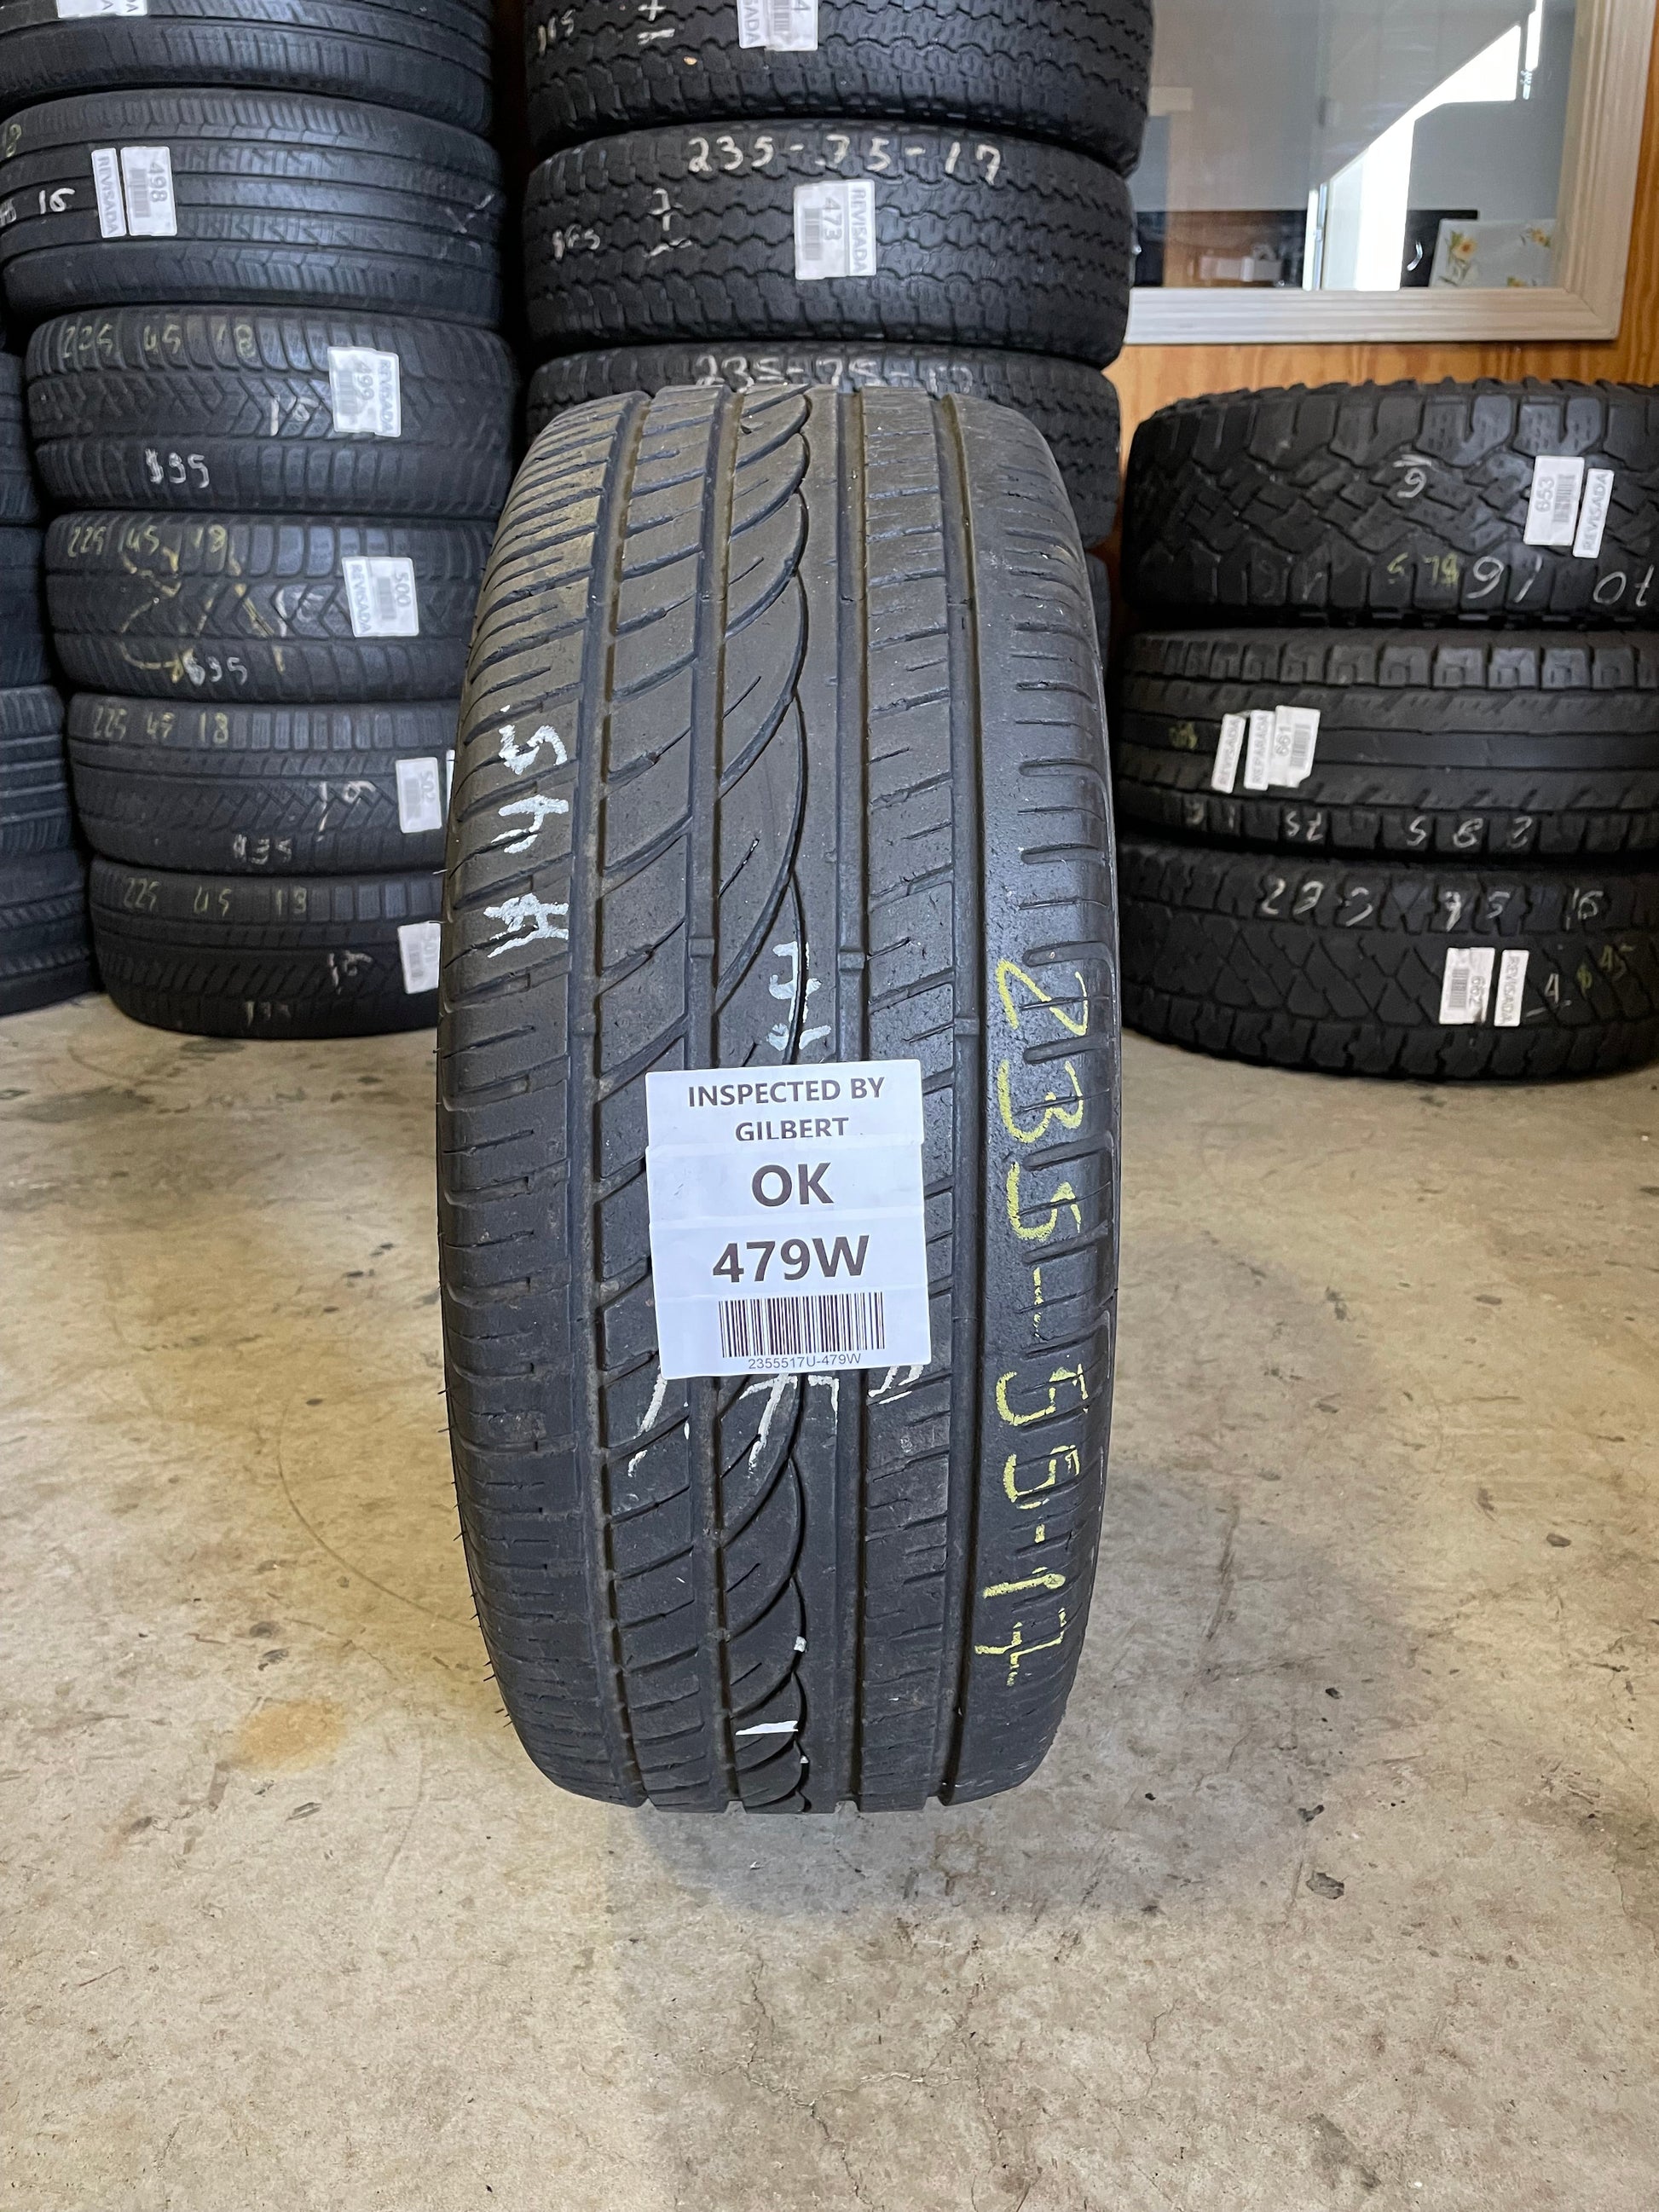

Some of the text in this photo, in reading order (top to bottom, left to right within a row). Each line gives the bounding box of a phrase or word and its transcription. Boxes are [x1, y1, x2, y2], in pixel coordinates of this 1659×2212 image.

[97, 155, 118, 234] REVISADA
[148, 162, 168, 204] 498
[821, 197, 842, 241] 473
[850, 188, 869, 274] REVISADA
[356, 361, 374, 401] 499
[378, 359, 394, 432] REVISADA
[1535, 476, 1555, 513] 653
[1583, 473, 1609, 551] REVISADA
[350, 563, 372, 632] REVISADA
[395, 571, 412, 608] 500
[199, 711, 229, 744] 18
[1275, 725, 1292, 757] 661
[1500, 955, 1521, 1025] REVISADA
[688, 1076, 885, 1107] INSPECTED BY
[735, 1117, 849, 1141] GILBERT
[751, 1162, 835, 1207] OK
[713, 1234, 870, 1283] 479W
[748, 1353, 862, 1370] 2355517U-479W
